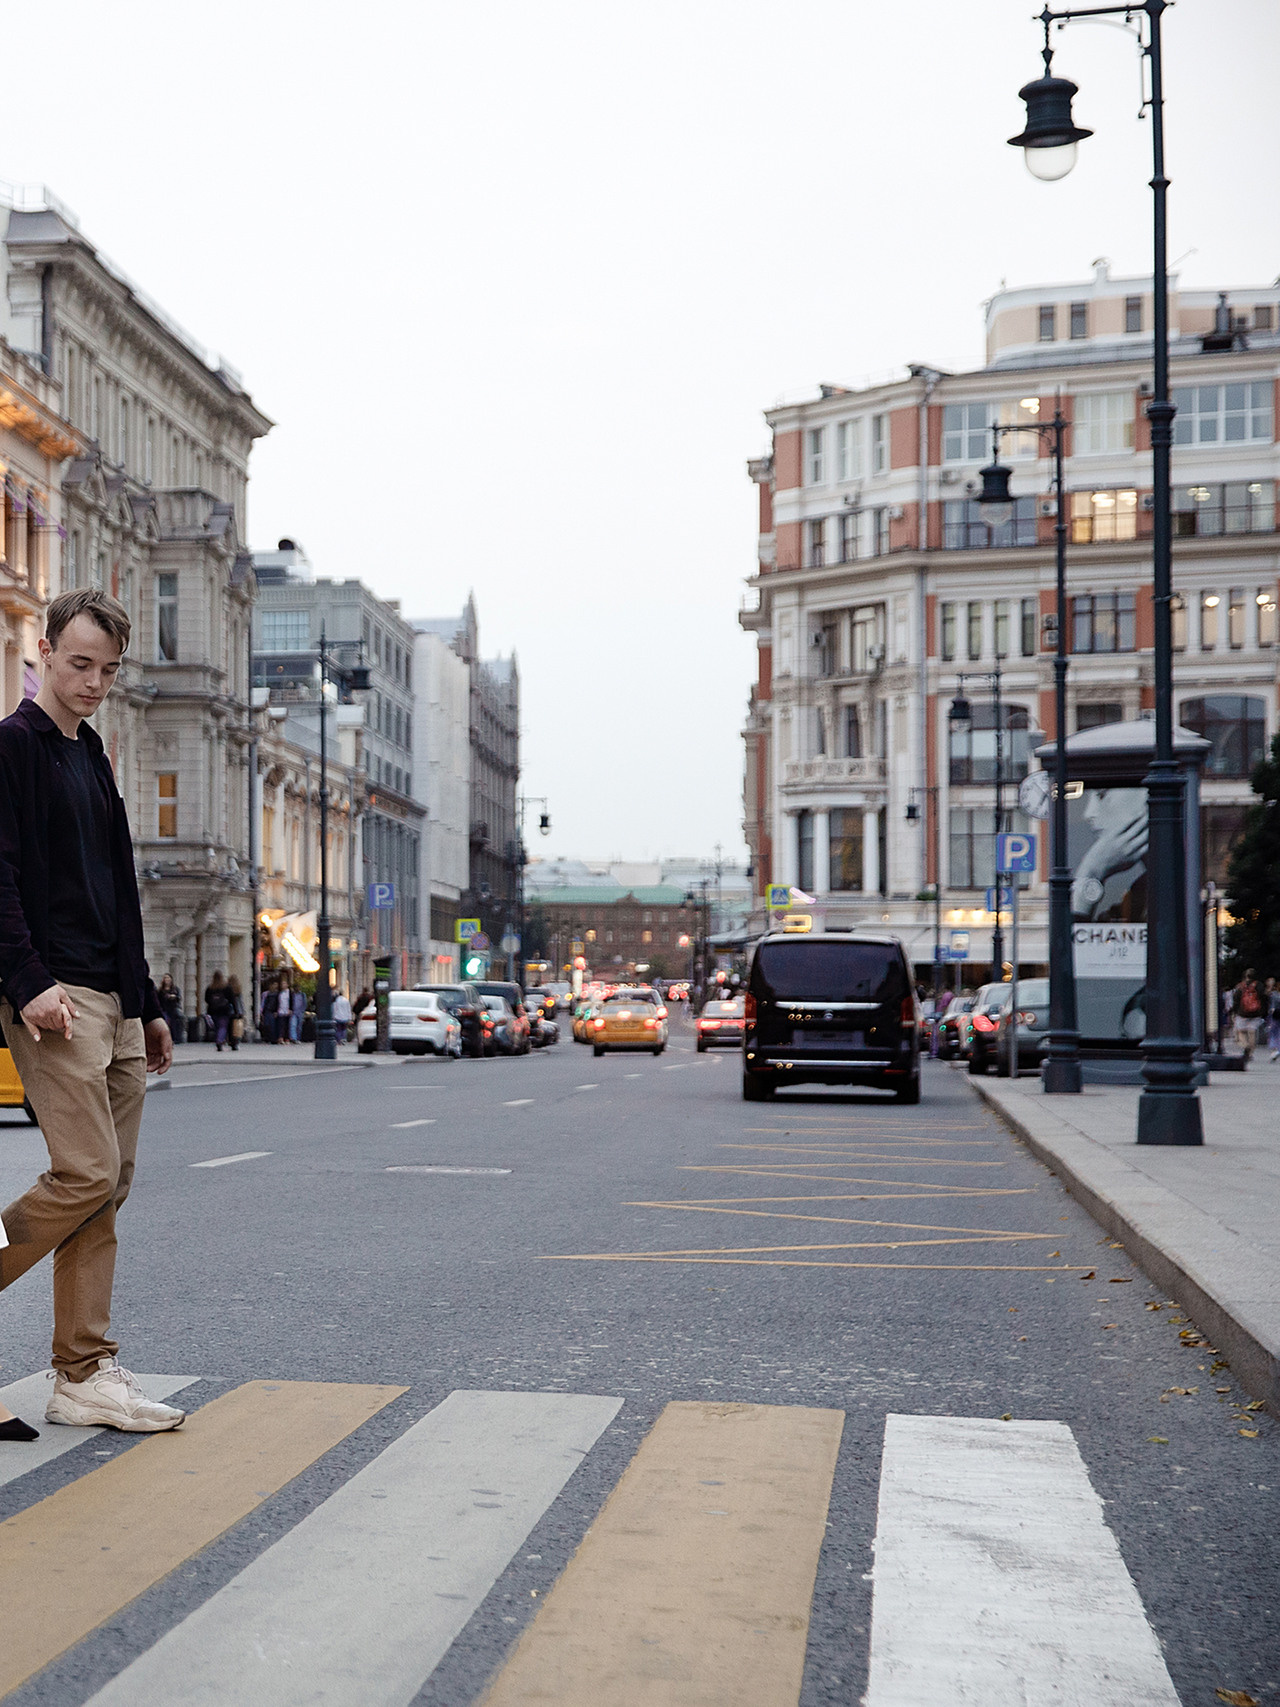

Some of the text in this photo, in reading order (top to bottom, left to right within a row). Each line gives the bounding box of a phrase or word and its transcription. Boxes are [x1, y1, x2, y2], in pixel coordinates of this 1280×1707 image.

[1004, 835, 1030, 869] P
[375, 885, 390, 906] P
[1075, 928, 1148, 943] CHANE
